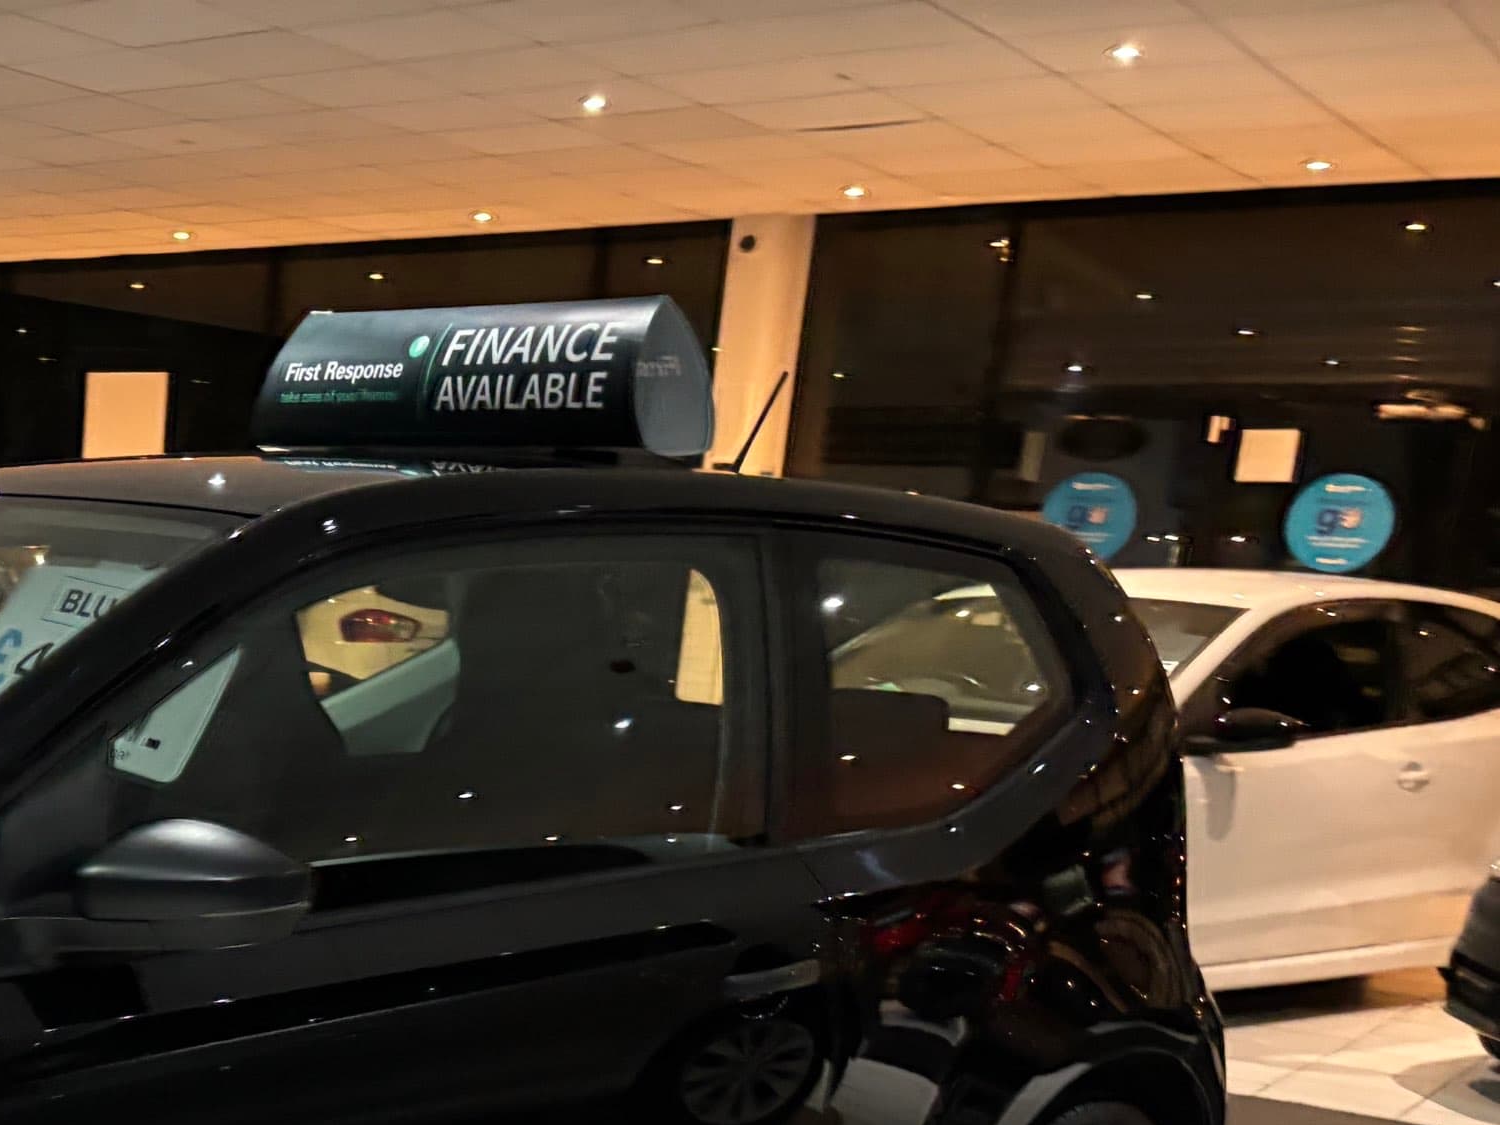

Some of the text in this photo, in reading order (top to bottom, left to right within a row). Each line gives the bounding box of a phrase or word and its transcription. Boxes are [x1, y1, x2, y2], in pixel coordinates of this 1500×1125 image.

[441, 322, 620, 367] FINANCE
[285, 361, 404, 384] First Response
[434, 372, 606, 411] AVAILABLE
